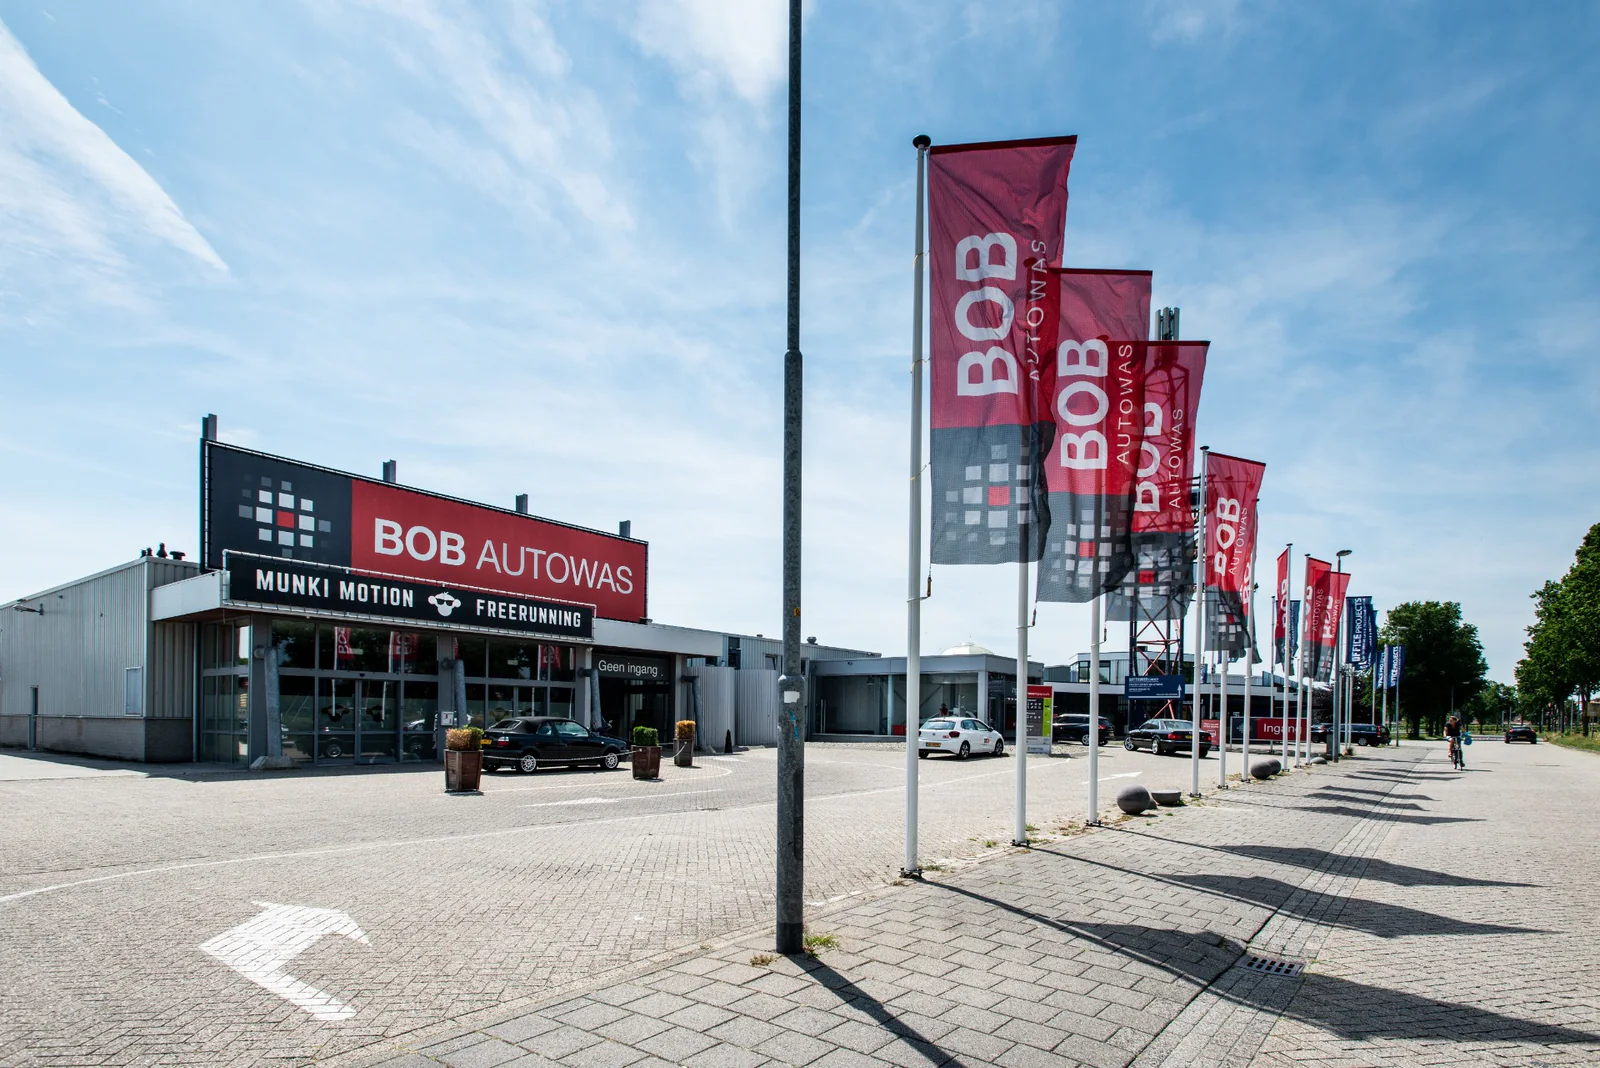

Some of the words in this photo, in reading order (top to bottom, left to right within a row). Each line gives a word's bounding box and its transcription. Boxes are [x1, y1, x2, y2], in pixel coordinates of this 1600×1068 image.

[955, 232, 1018, 396] BOB
[1026, 239, 1046, 381] AUTOWAS
[1057, 339, 1109, 470] BOB
[1116, 344, 1133, 465] AUTOWAS
[1168, 408, 1183, 508] AUTOWAS
[374, 517, 466, 566] BOB
[476, 539, 633, 595] AUTOWAS
[1214, 497, 1241, 577] BOB
[1228, 507, 1248, 576] AUTOWAS
[256, 569, 328, 599] MUNKI
[339, 580, 414, 608] MOTION
[476, 600, 581, 628] FREERUNNING
[1354, 597, 1363, 633] PROJECTS
[598, 659, 625, 672] Geen
[627, 662, 658, 677] ingang
